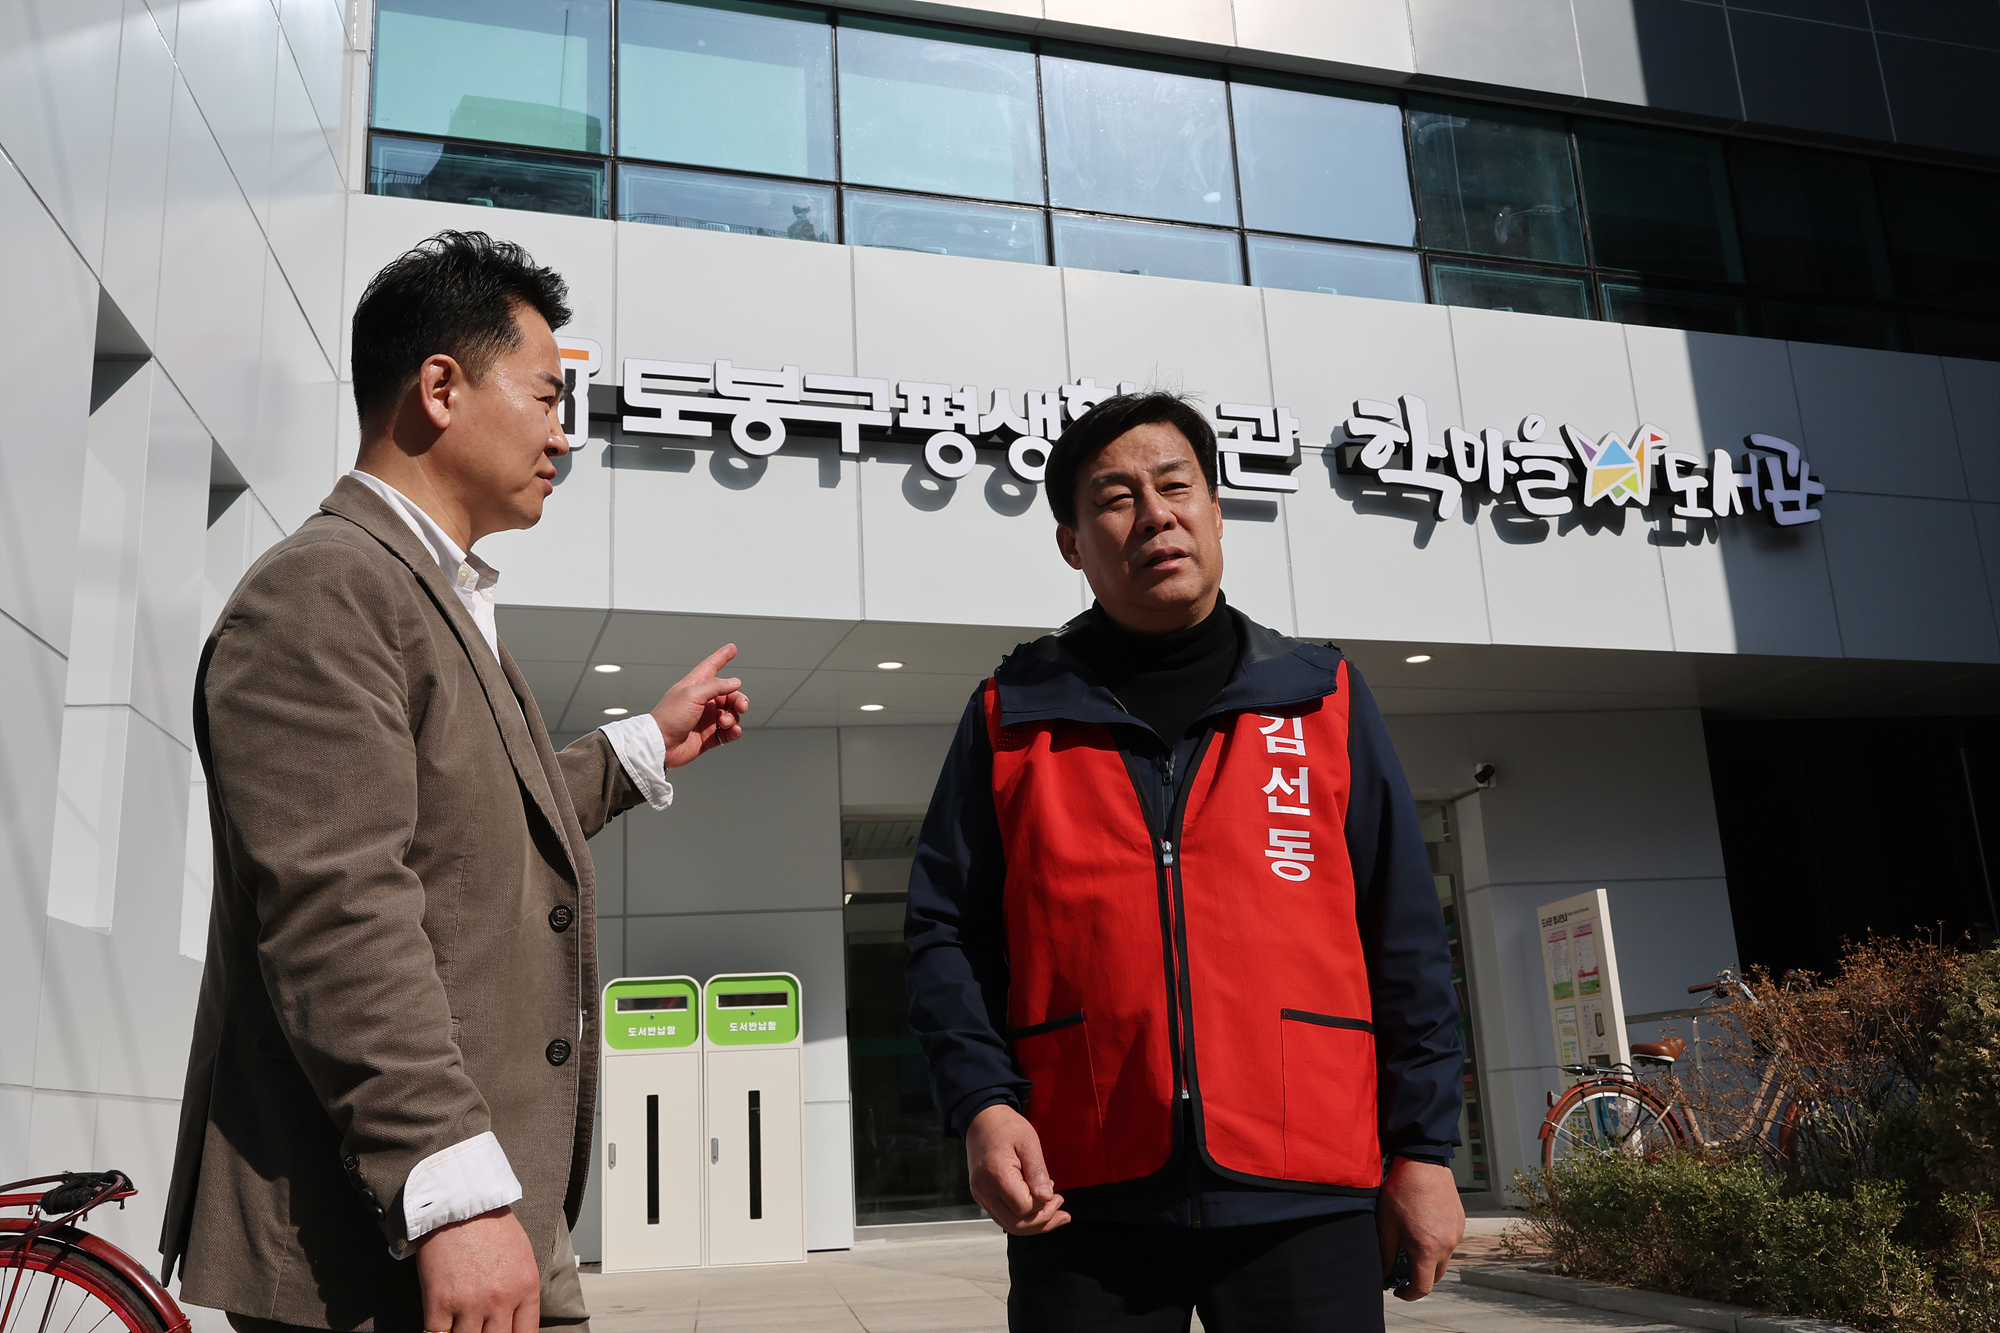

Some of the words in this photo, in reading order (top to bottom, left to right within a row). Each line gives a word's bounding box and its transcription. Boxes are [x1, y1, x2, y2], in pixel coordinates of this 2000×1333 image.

[622, 358, 1300, 493] 도봉구평생관
[1258, 711, 1315, 882] 김선동
[628, 1025, 676, 1037] 도서반납함
[729, 1021, 777, 1032] 도서반납함
